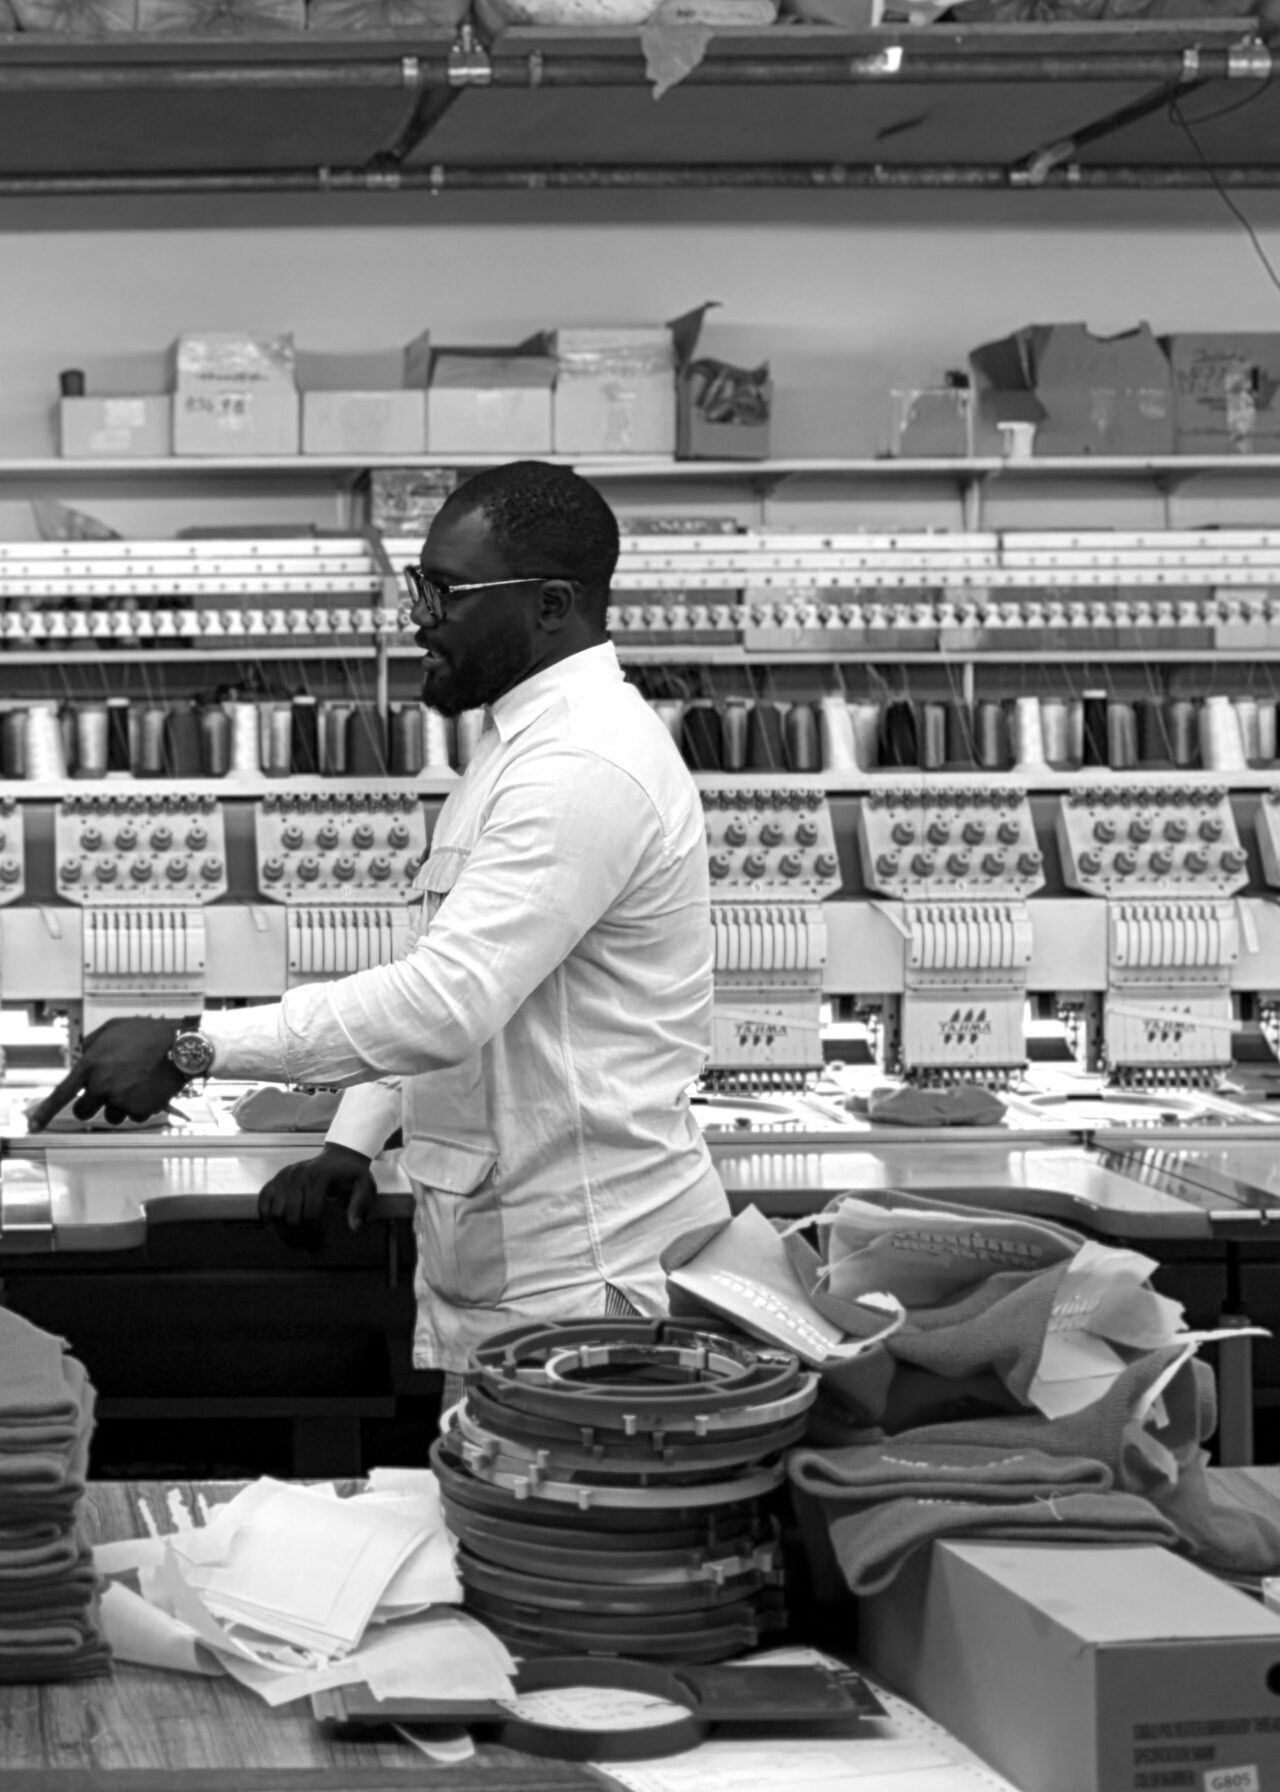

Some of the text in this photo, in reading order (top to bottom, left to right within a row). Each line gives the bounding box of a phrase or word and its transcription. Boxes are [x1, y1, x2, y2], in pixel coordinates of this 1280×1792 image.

[735, 1024, 787, 1036] TAJIMA
[939, 1022, 991, 1034] TAJIMA
[1211, 1772, 1251, 1790] G805
